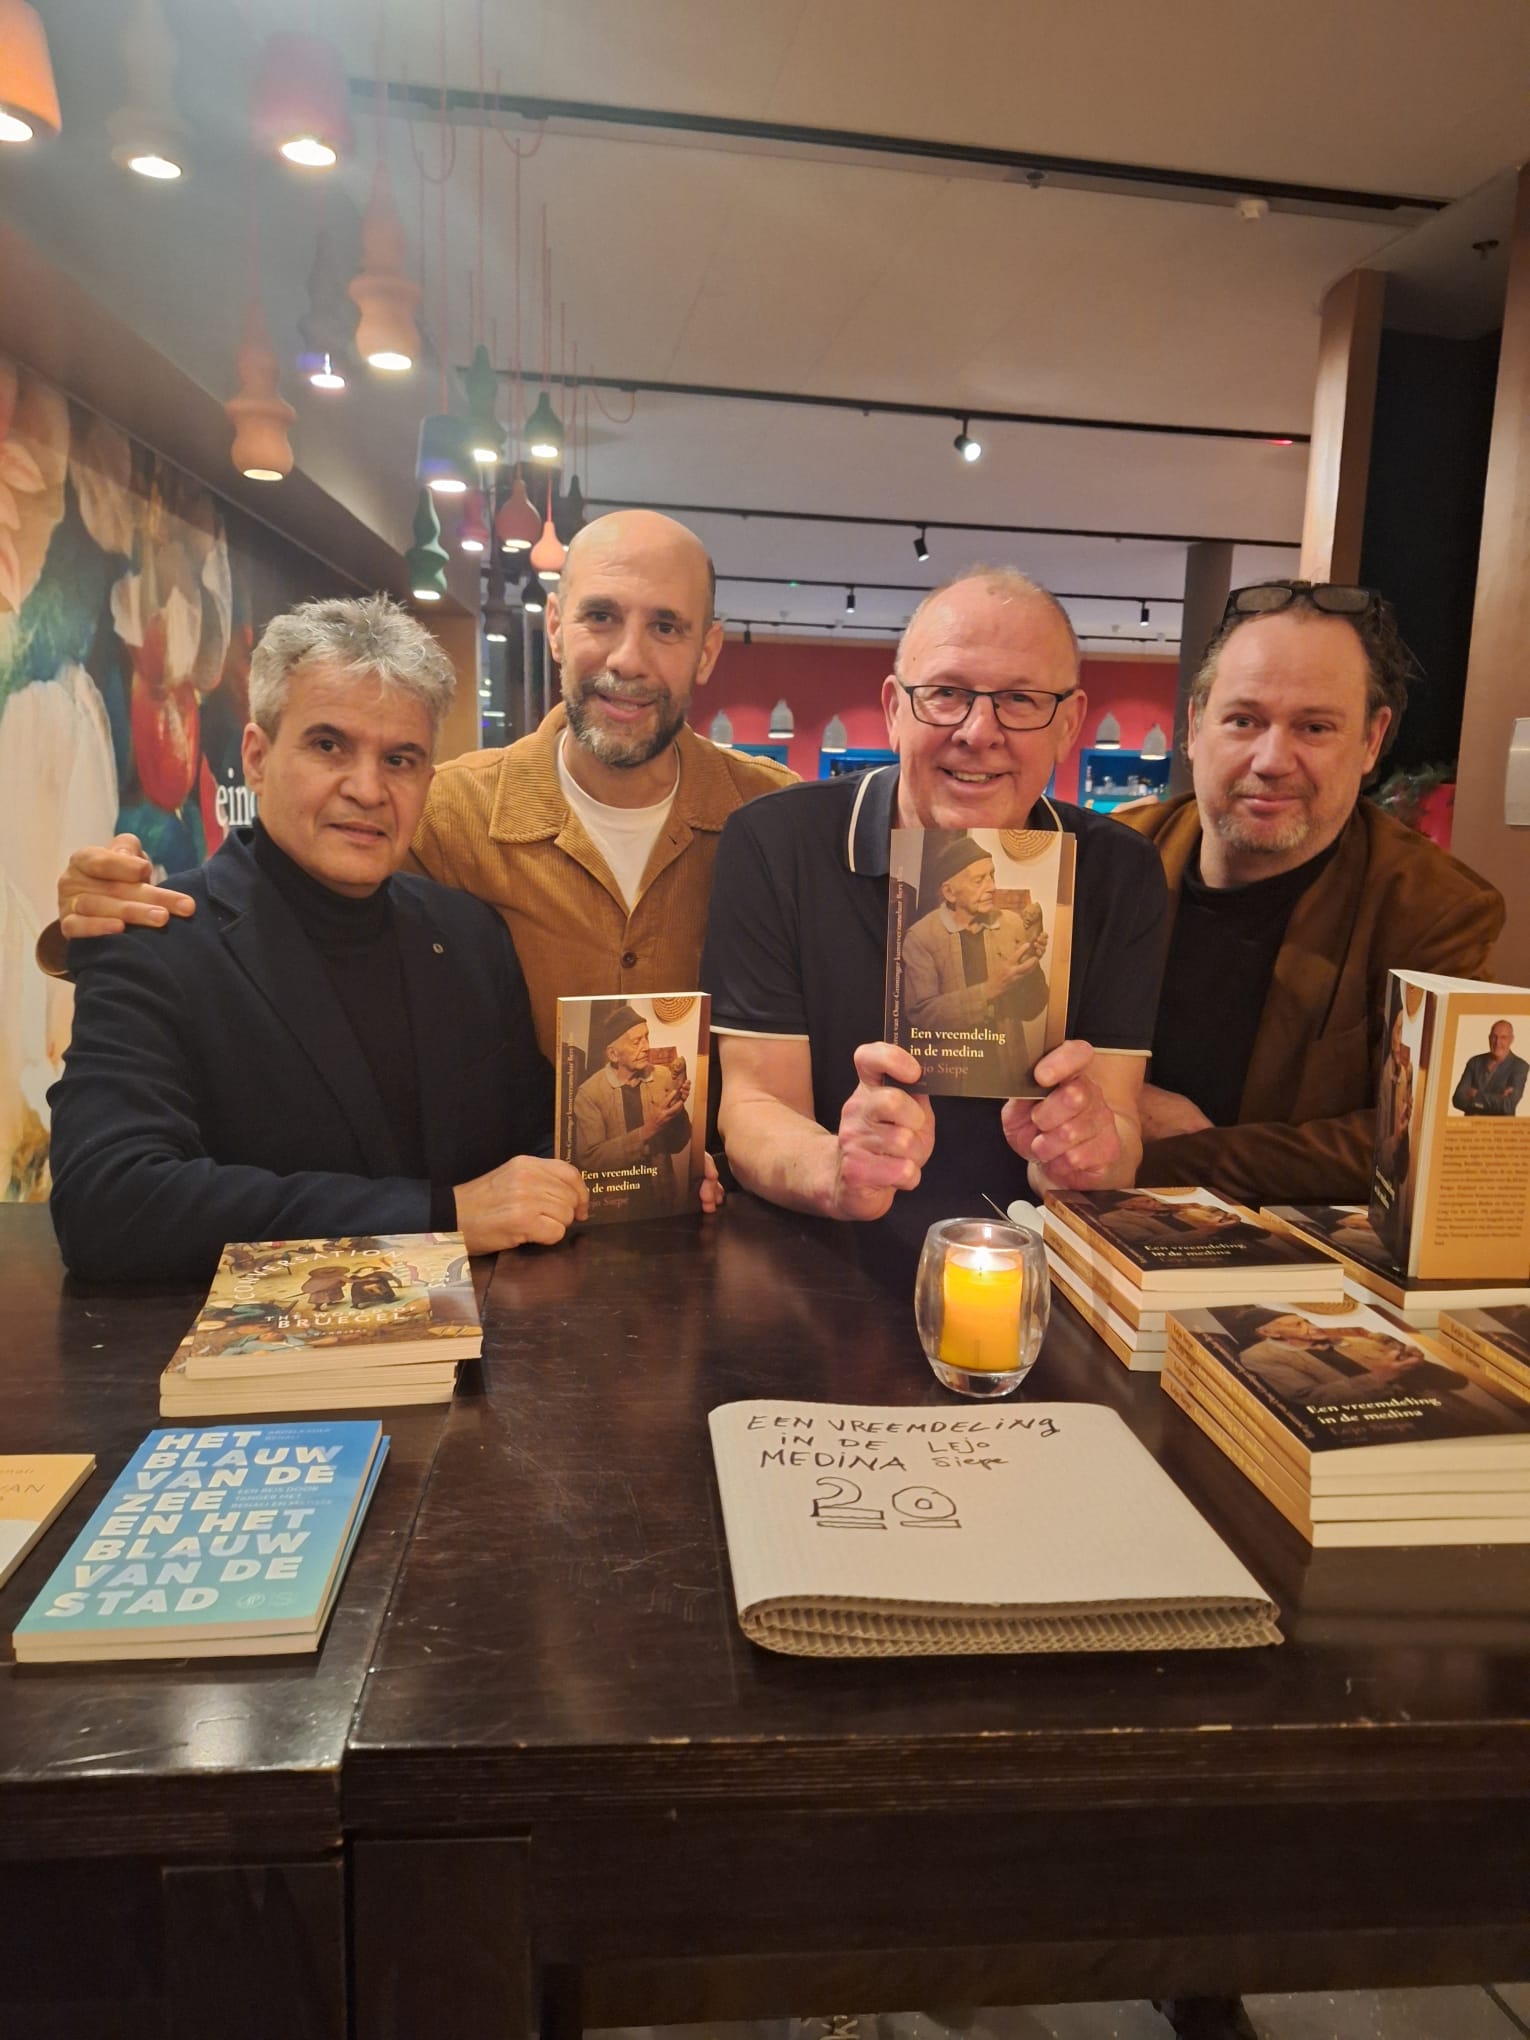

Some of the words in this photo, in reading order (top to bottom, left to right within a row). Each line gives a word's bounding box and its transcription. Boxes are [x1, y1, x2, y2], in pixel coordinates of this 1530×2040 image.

[911, 1027, 932, 1039] Een
[935, 1028, 1007, 1046] vreemdeling
[910, 1044, 921, 1057] in
[924, 1043, 939, 1057] de
[941, 1044, 984, 1058] medina
[581, 1170, 599, 1180] Een
[601, 1164, 658, 1177] vreemdeling
[592, 1183, 604, 1193] de
[606, 1180, 641, 1193] medina
[1186, 1248, 1232, 1256] medina
[278, 1312, 411, 1330] BRUEGEL
[1305, 1405, 1339, 1415] Een
[1341, 1396, 1443, 1411] vreemdeling
[747, 1416, 815, 1430] EEN
[1316, 1415, 1337, 1425] in
[1340, 1413, 1360, 1423] de
[1363, 1409, 1424, 1422] medina
[155, 1430, 262, 1450] HET
[838, 1437, 888, 1451] DE
[142, 1445, 344, 1469] BLAUW
[136, 1467, 249, 1490] VAN
[264, 1465, 337, 1486] DE
[113, 1490, 228, 1512] ZEE
[99, 1514, 184, 1537] EN
[198, 1508, 315, 1534] HET
[82, 1531, 312, 1562] BLAUW
[75, 1561, 203, 1588] VAN
[219, 1556, 304, 1582] DE
[44, 1587, 220, 1617] STAD
